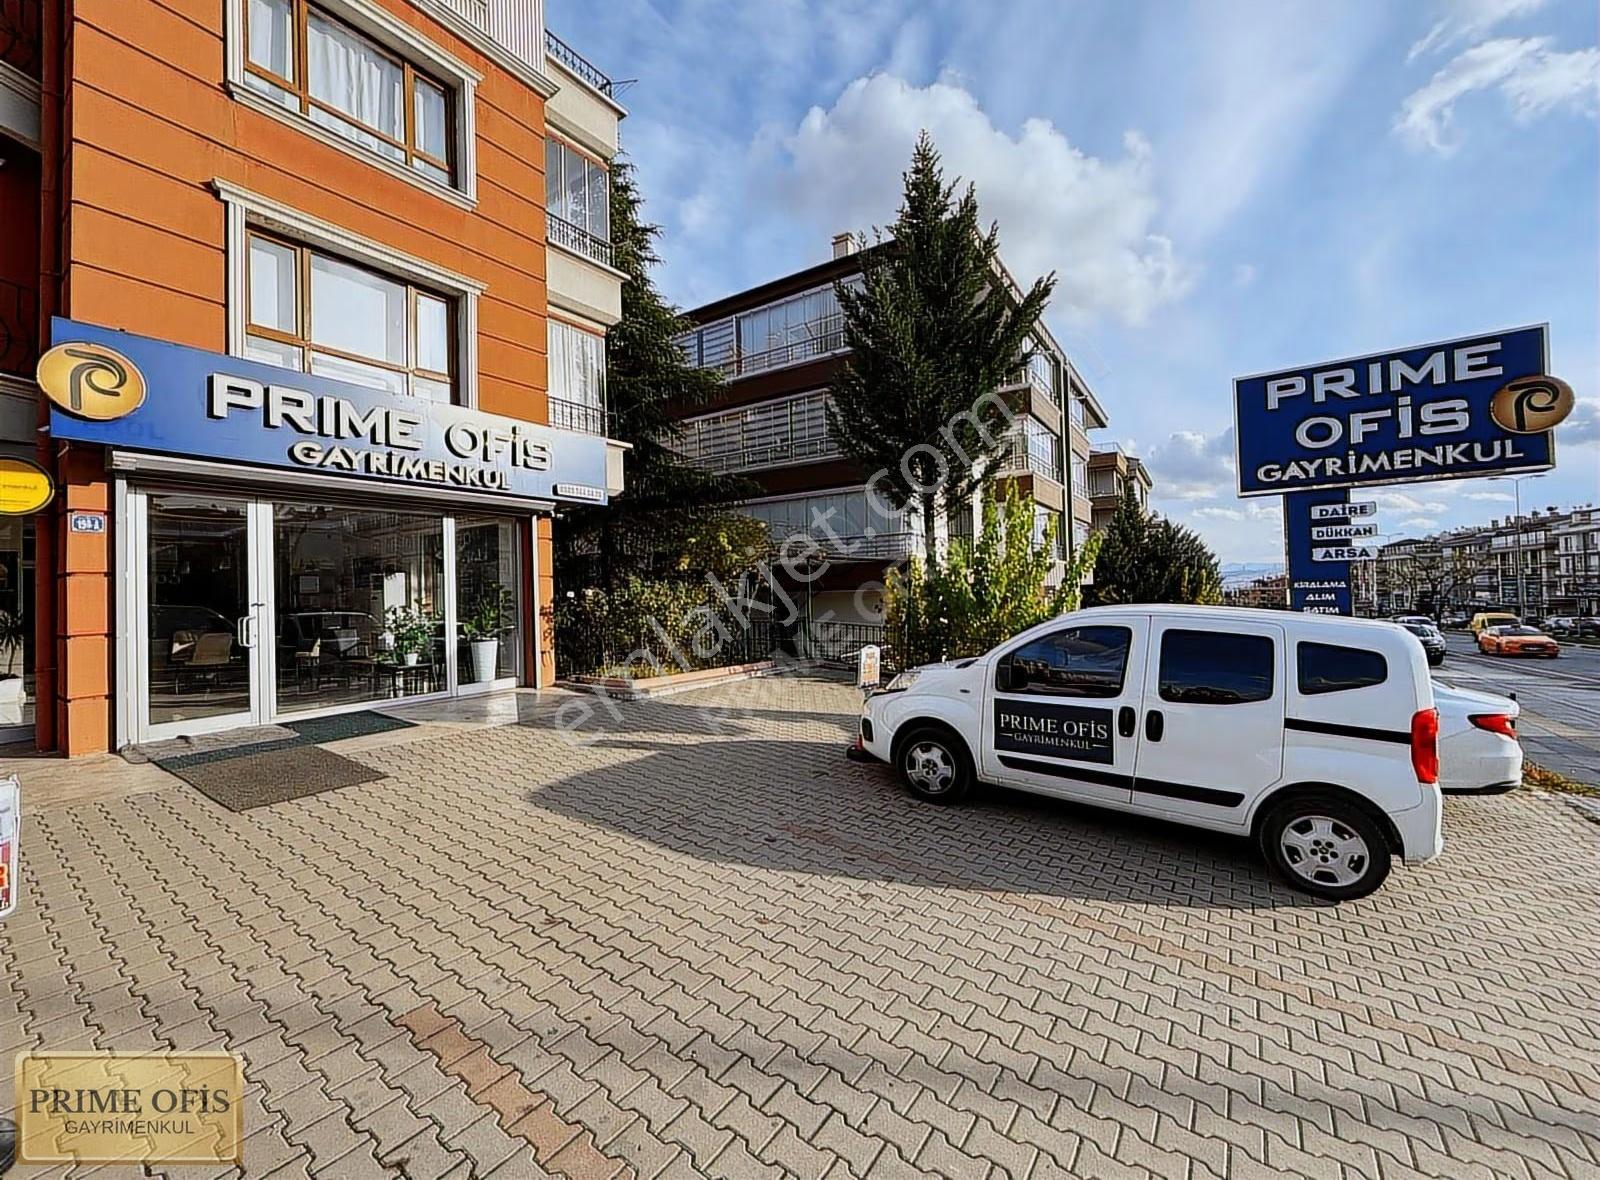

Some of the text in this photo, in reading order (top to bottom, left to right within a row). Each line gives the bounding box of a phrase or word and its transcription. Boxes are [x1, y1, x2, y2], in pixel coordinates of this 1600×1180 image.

[1266, 341, 1504, 410] PRIME
[207, 372, 553, 471] PRIME OFİS
[1294, 395, 1470, 449] OFİS
[288, 441, 512, 490] GAYRİMENKUL
[1256, 438, 1525, 483] GAYRİMENKUL
[1319, 504, 1369, 517] DAİRE
[1316, 526, 1373, 538] DÜKKAN
[1321, 548, 1371, 560] ARSA
[1305, 593, 1336, 601] ALIM
[1000, 713, 1108, 740] PRIME OFİS
